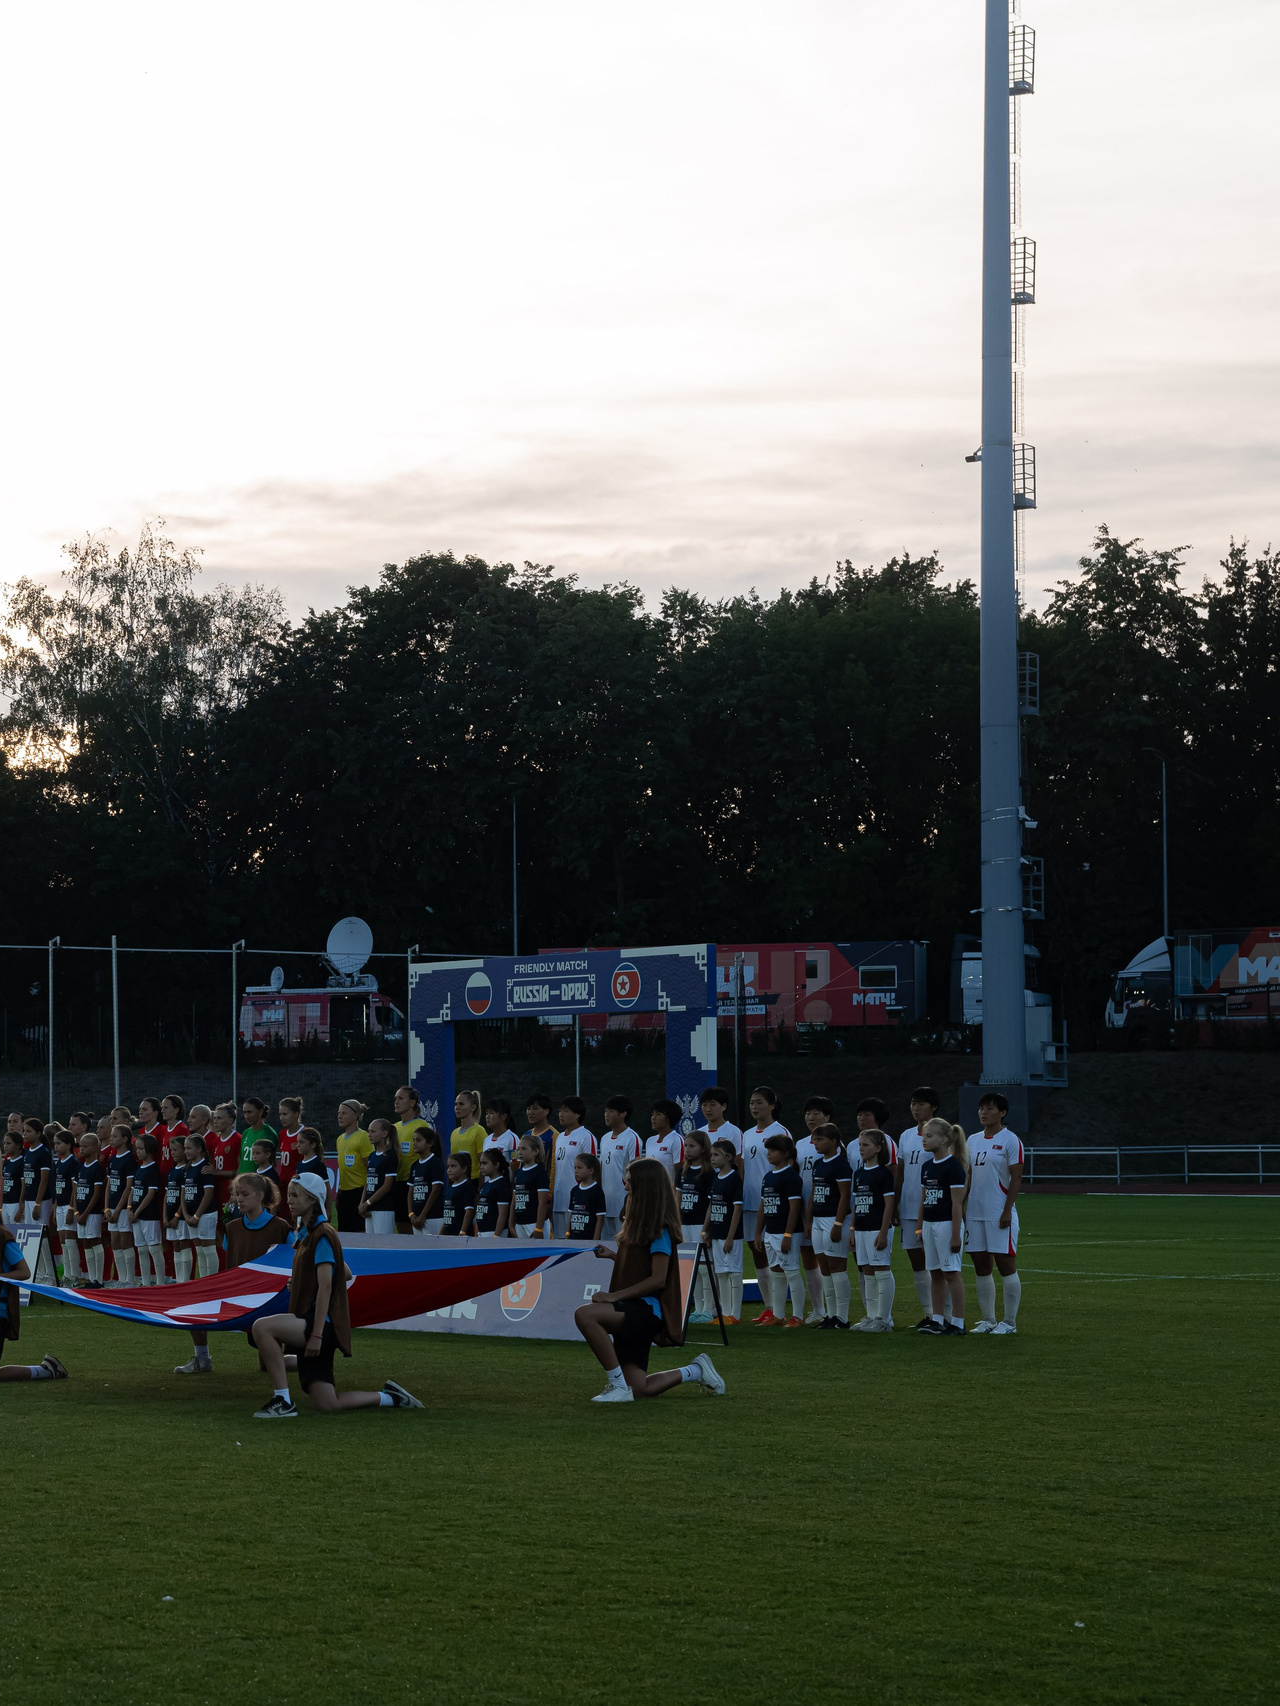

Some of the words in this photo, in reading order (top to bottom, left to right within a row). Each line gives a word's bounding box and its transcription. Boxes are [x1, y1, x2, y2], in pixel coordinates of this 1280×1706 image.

[514, 962, 555, 974] FRIENDLY
[556, 960, 588, 971] MATCH
[852, 992, 896, 1006] МАТЧ!
[243, 1146, 253, 1161] 21
[605, 1151, 611, 1164] 3
[750, 1145, 757, 1159] 9
[909, 1150, 920, 1165] 11
[974, 1151, 987, 1166] 12
[215, 1155, 224, 1170] 18
[803, 1156, 813, 1171] 15
